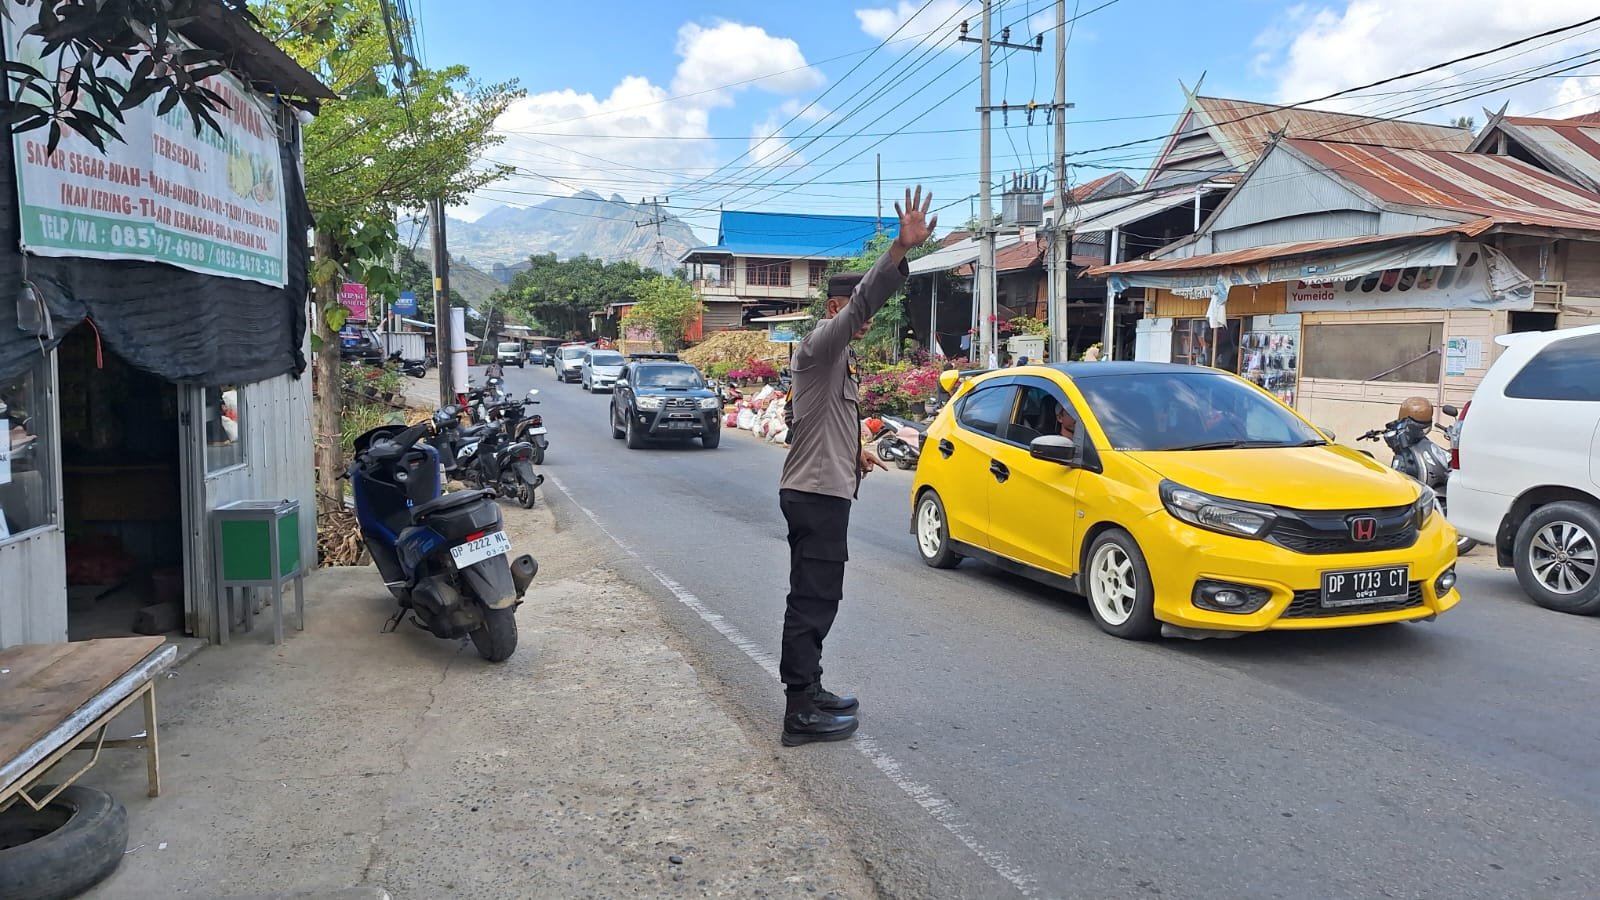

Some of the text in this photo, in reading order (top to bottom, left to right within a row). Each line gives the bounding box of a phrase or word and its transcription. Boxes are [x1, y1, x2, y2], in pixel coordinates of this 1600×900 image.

[26, 140, 66, 171] SAYUR
[153, 133, 201, 172] TERSEDIA
[61, 183, 89, 207] IKAN
[1292, 291, 1335, 302] Yumeida
[451, 532, 507, 558] DP 2222 NL
[1329, 569, 1405, 593] DP 1713 CT
